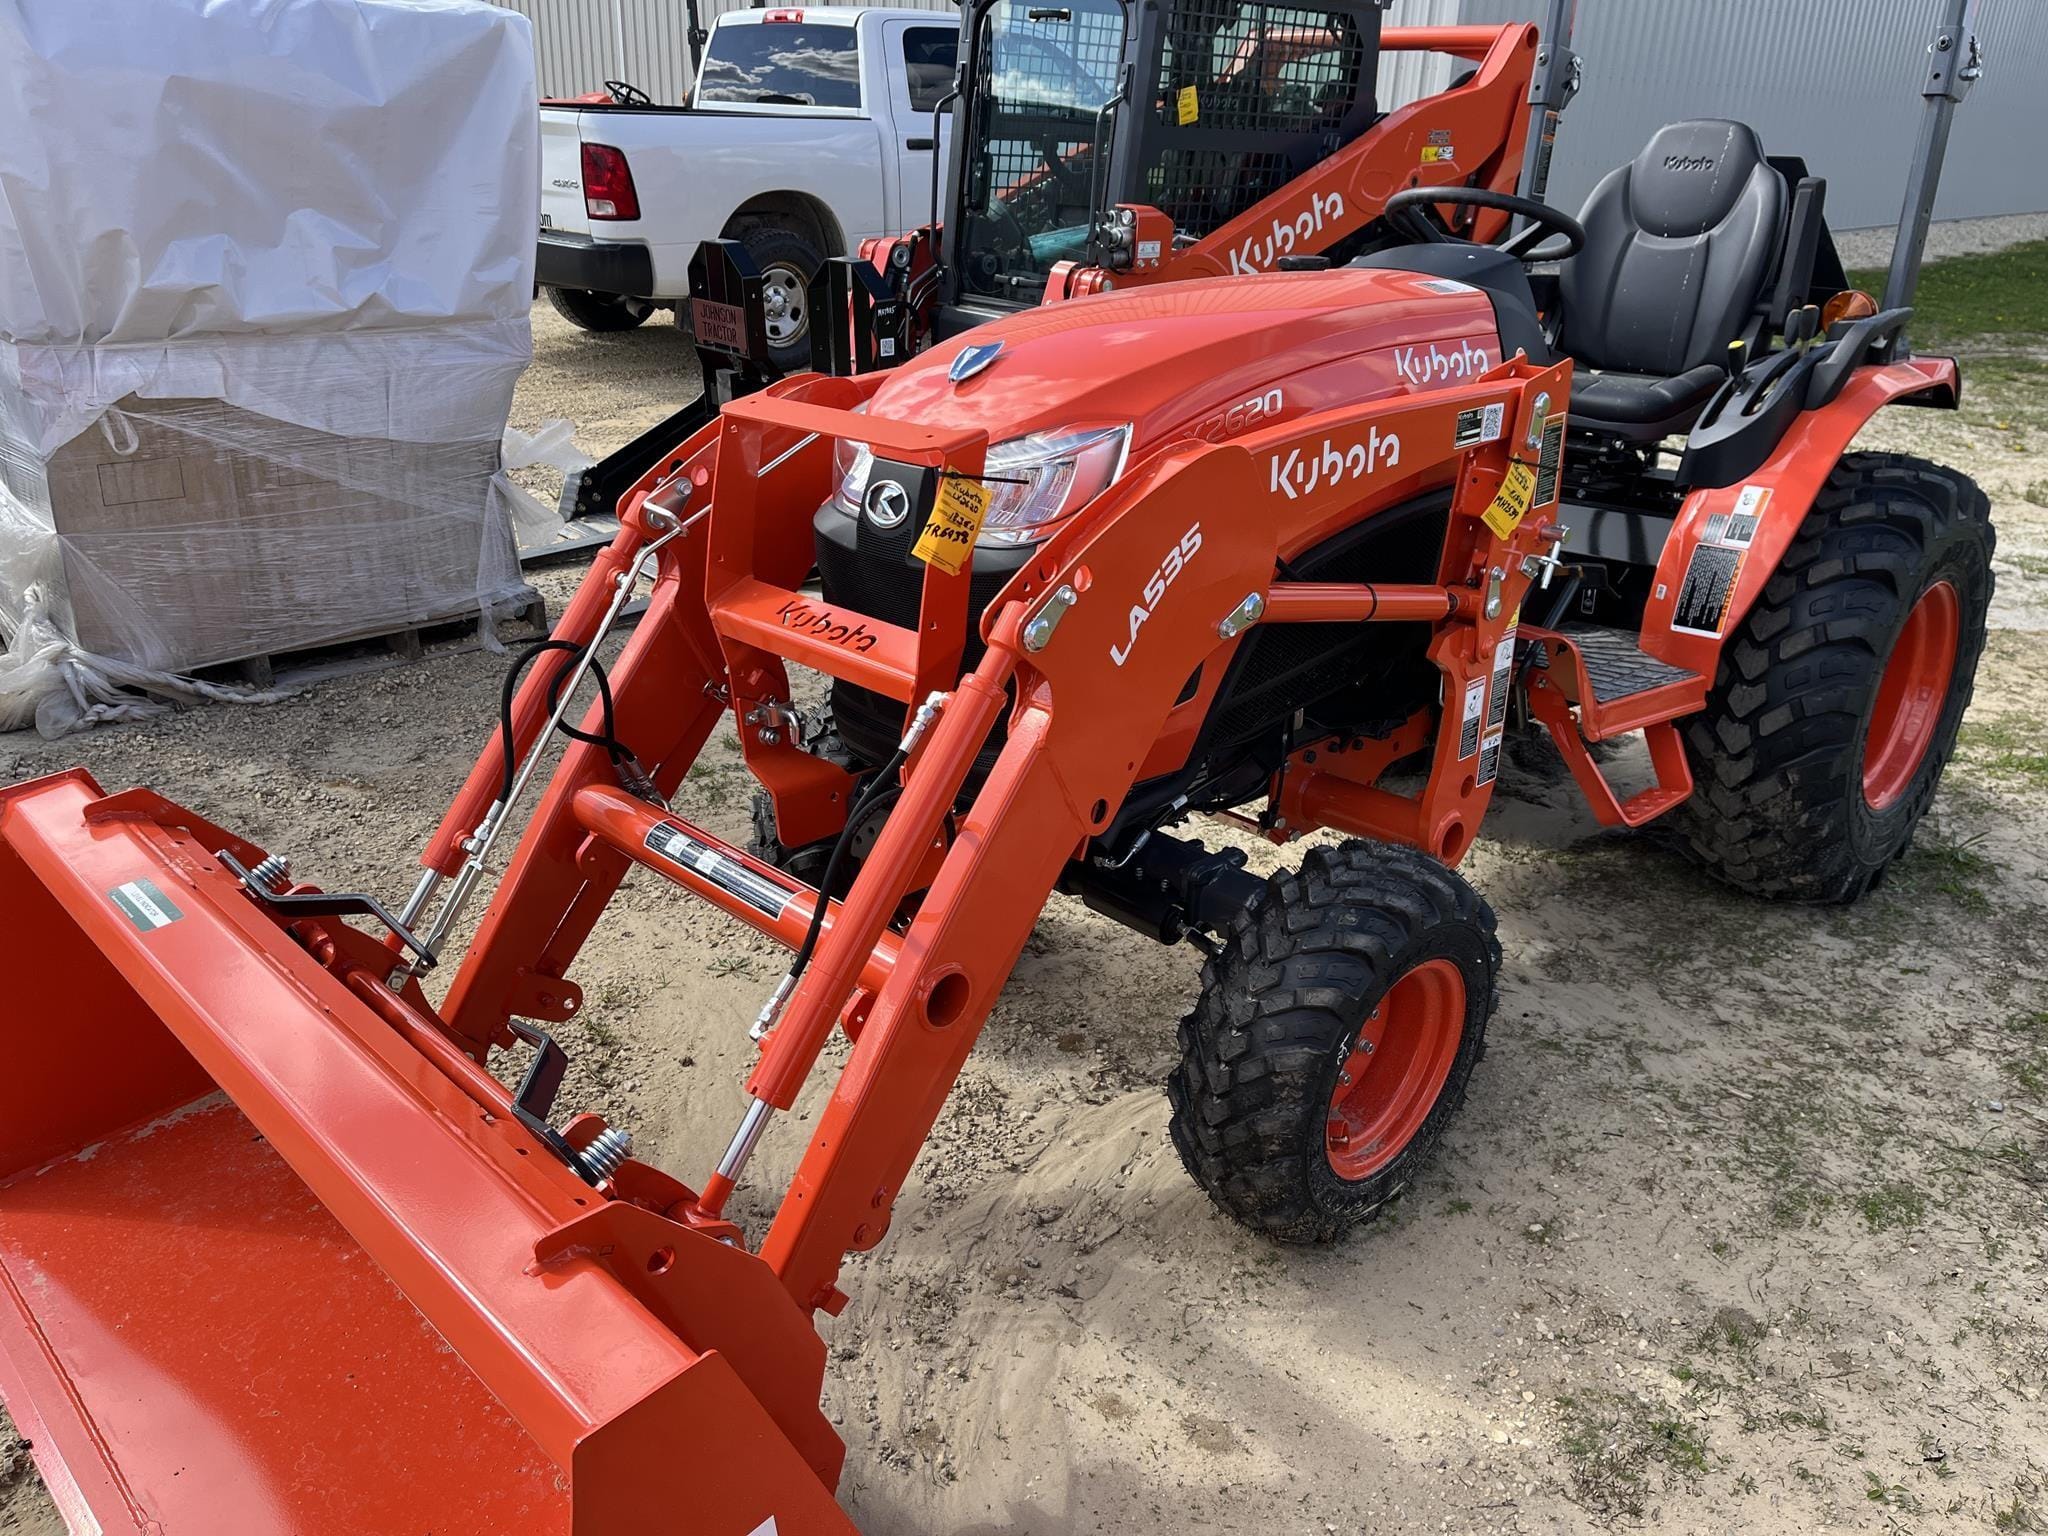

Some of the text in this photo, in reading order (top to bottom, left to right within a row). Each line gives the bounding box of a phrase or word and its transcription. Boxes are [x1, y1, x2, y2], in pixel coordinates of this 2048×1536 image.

[1663, 156, 1714, 170] Kubota
[1229, 192, 1344, 275] Kubota
[700, 303, 737, 325] JOHNSON
[702, 321, 737, 344] TRACTOR
[1394, 340, 1489, 384] Kubota
[1270, 426, 1400, 499] Kubota
[1109, 521, 1202, 666] LA535
[776, 600, 877, 652] Kubota
